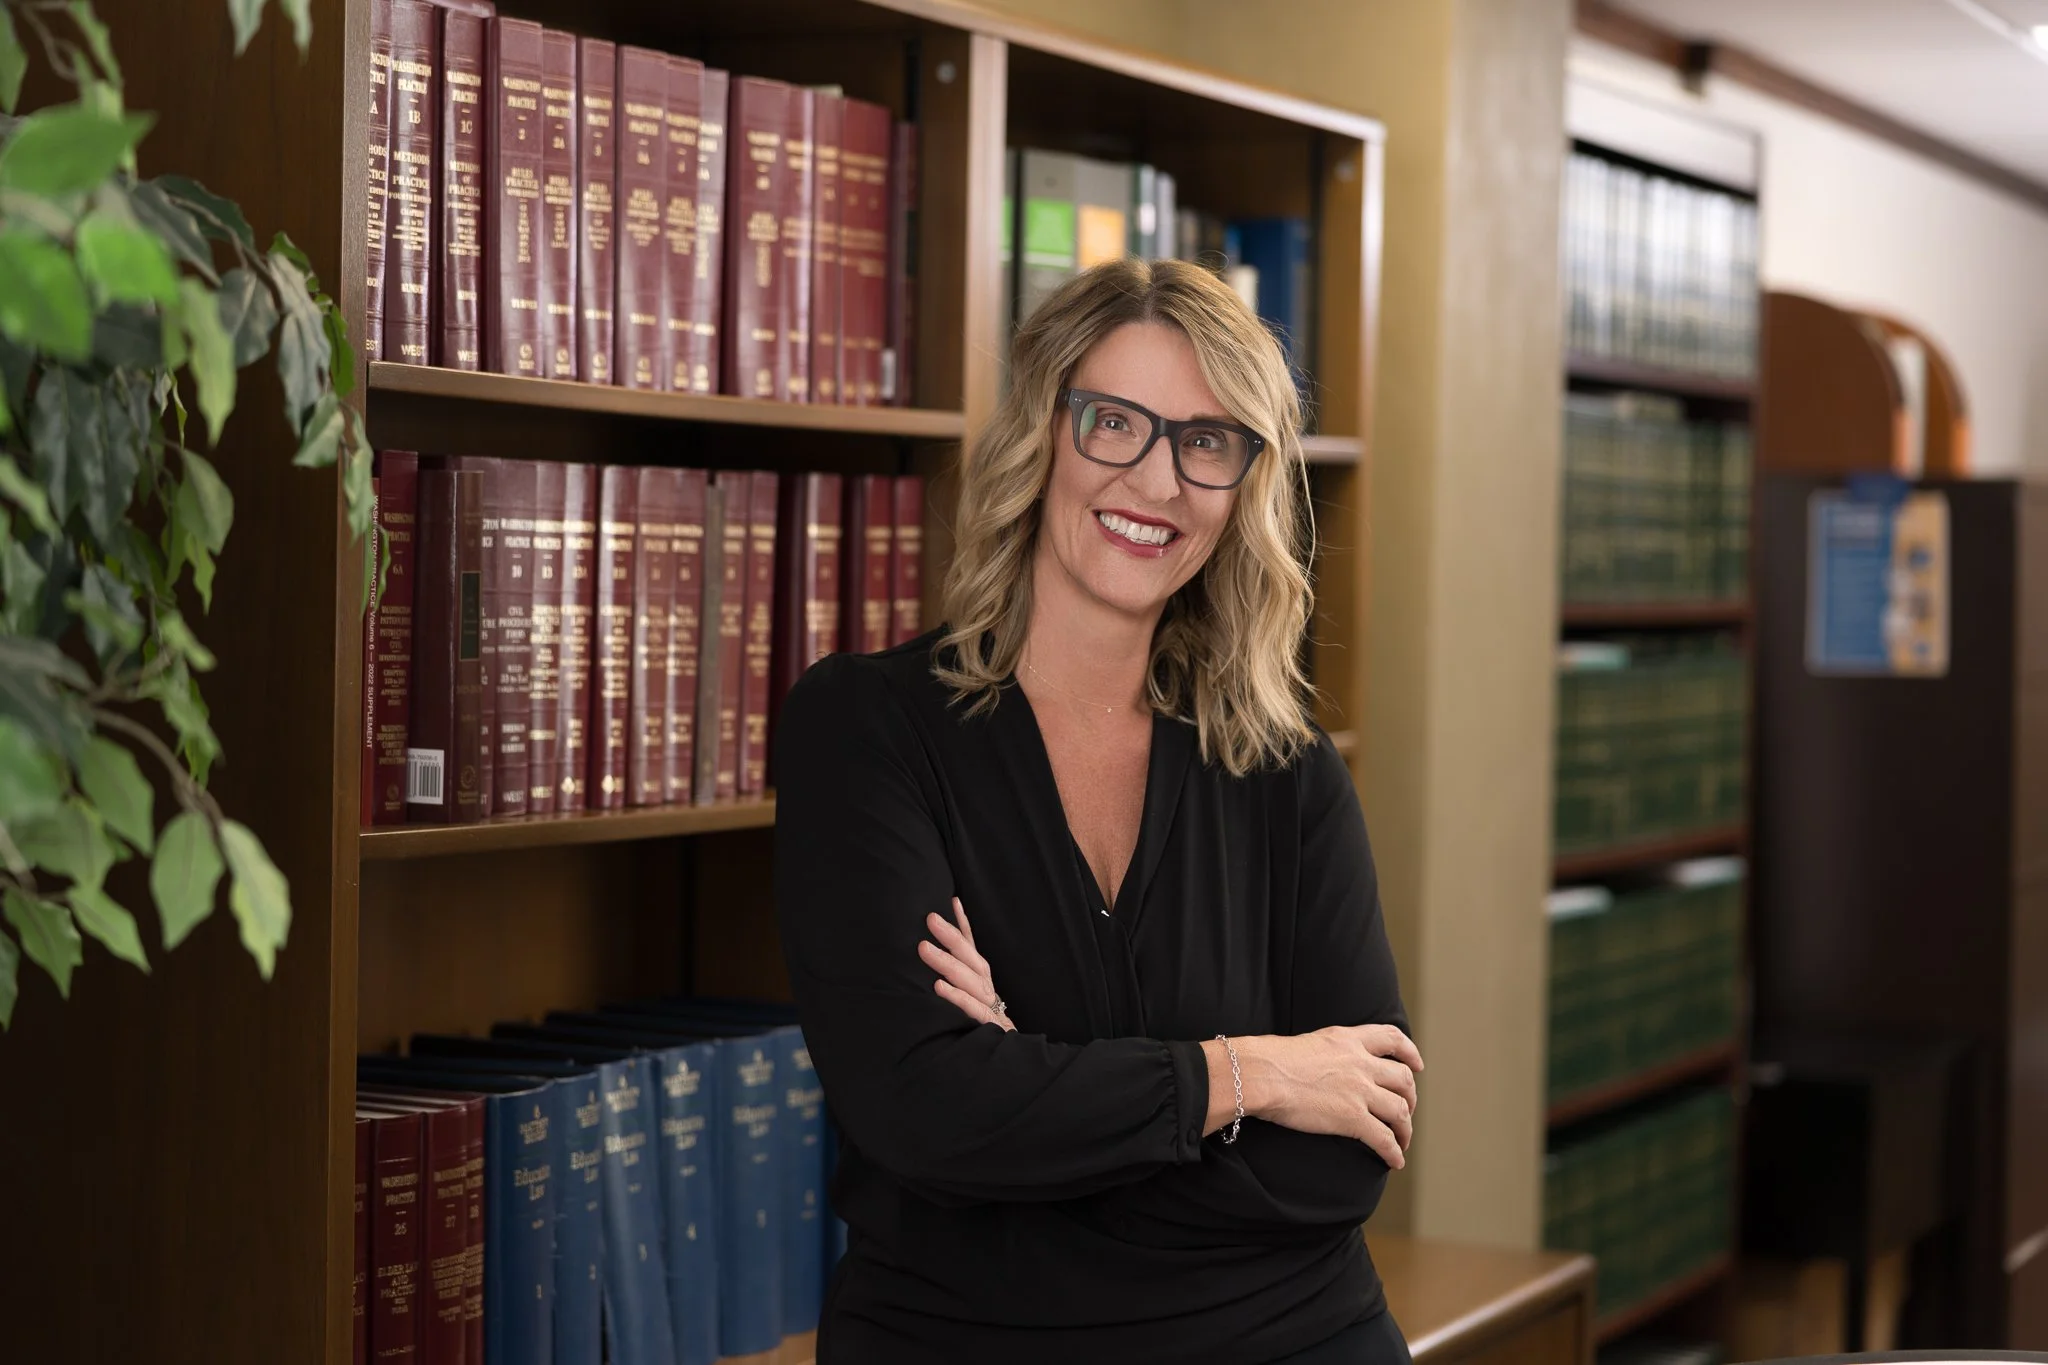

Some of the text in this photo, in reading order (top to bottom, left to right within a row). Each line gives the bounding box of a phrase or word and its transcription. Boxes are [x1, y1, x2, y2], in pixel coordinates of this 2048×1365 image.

[370, 51, 391, 67] NGTON
[392, 59, 432, 77] WASHINGTON
[398, 78, 427, 95] PRACTICE
[370, 100, 378, 114] A
[408, 110, 421, 124] 1B
[460, 120, 473, 134] 1C
[518, 128, 526, 140] 2
[369, 144, 387, 156] HODS
[394, 151, 430, 166] METHODS
[369, 168, 386, 181] TICE
[409, 166, 418, 175] OF
[393, 175, 430, 189] PRACTICE
[366, 339, 378, 350] EST
[401, 344, 425, 357] WEST
[393, 564, 403, 575] 6A
[513, 1165, 550, 1187] Educati
